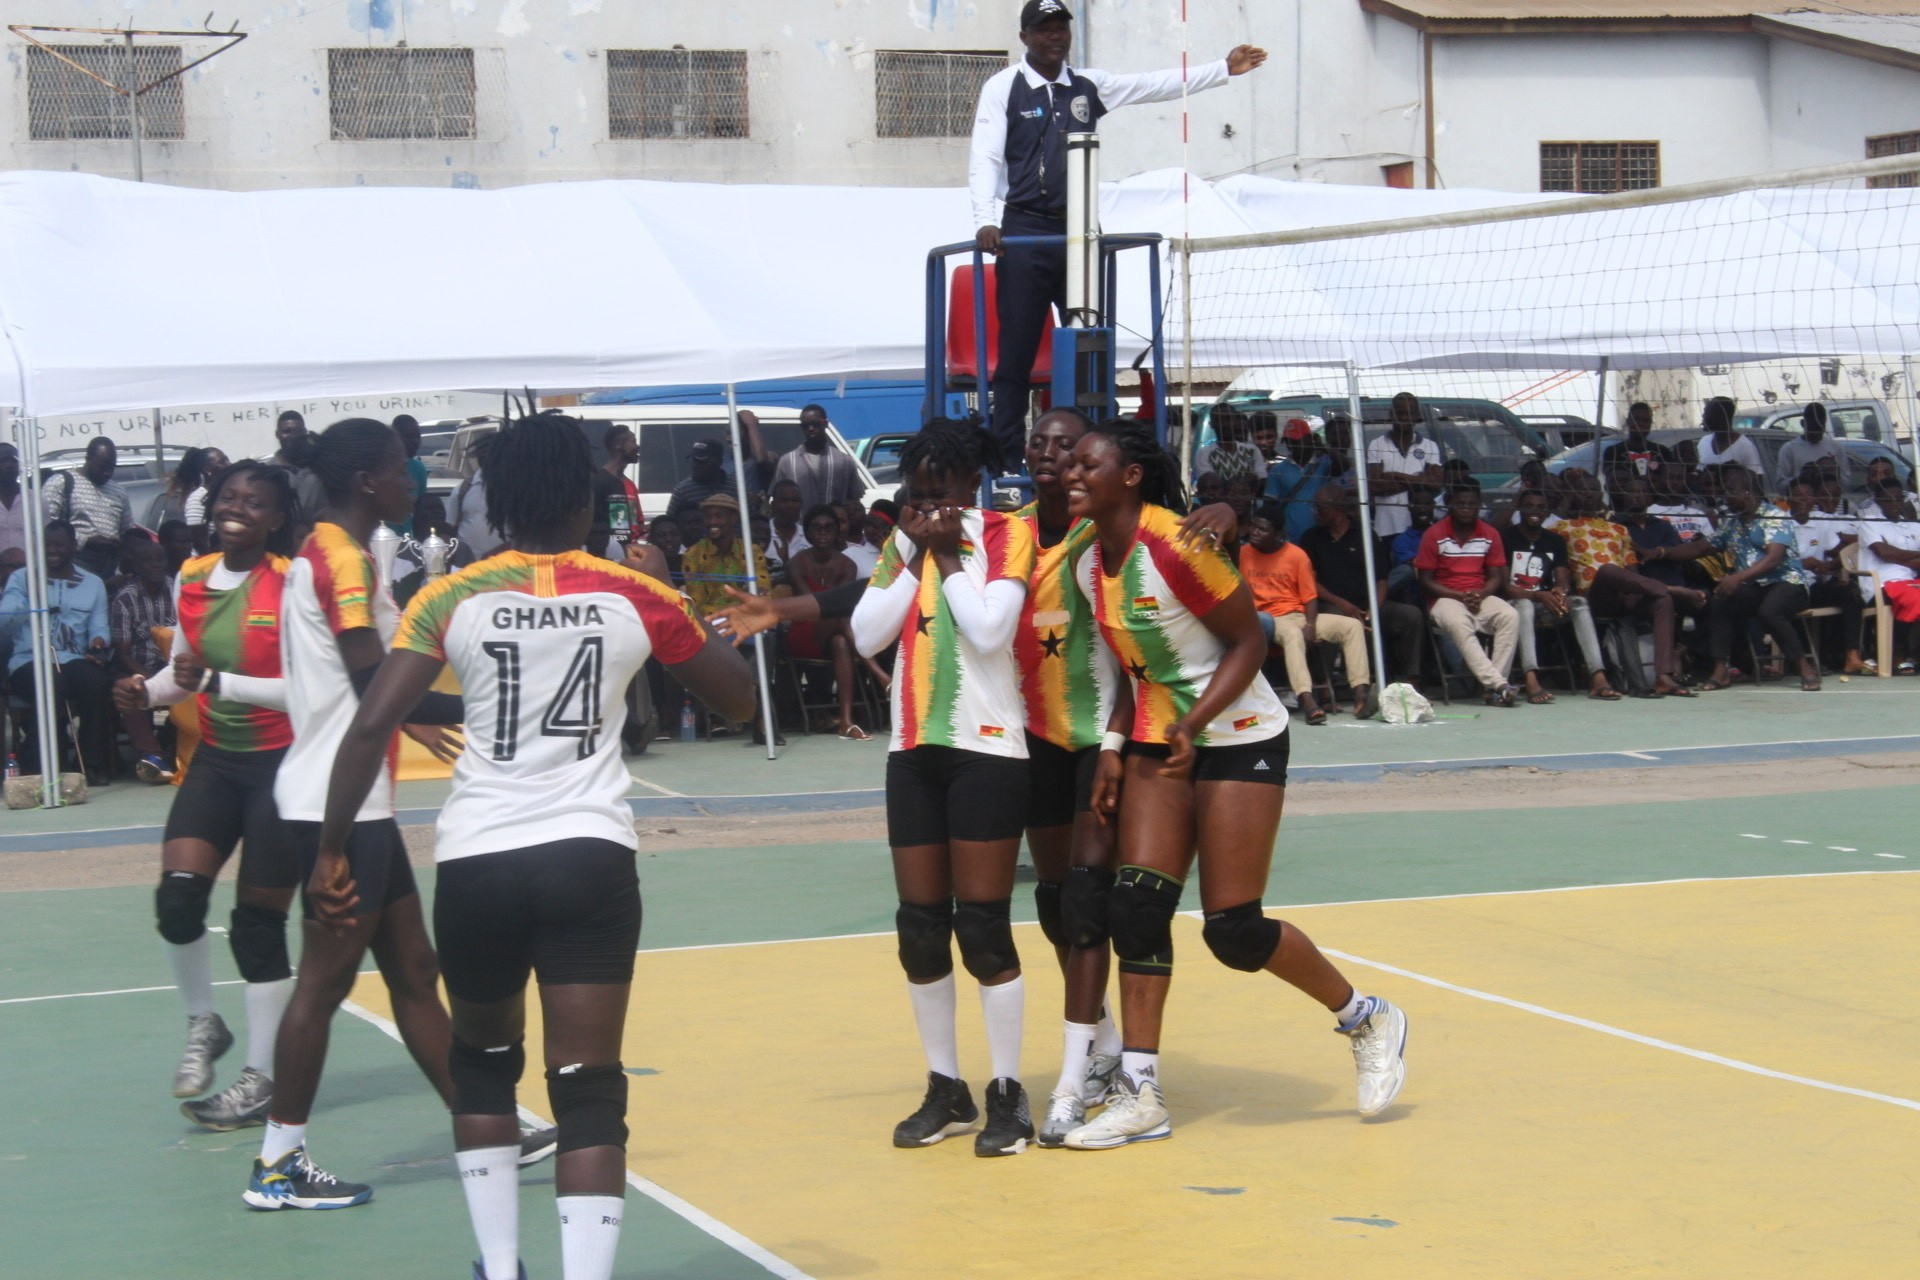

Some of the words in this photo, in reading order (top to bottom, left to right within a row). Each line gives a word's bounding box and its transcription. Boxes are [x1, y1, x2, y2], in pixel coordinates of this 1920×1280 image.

[60, 421, 105, 437] NOT
[119, 411, 215, 432] URNATE
[232, 406, 285, 422] HERE
[302, 404, 317, 415] IF
[331, 401, 367, 413] YOU
[379, 395, 457, 411] URINATE
[492, 604, 605, 630] GHANA
[482, 636, 604, 762] 14
